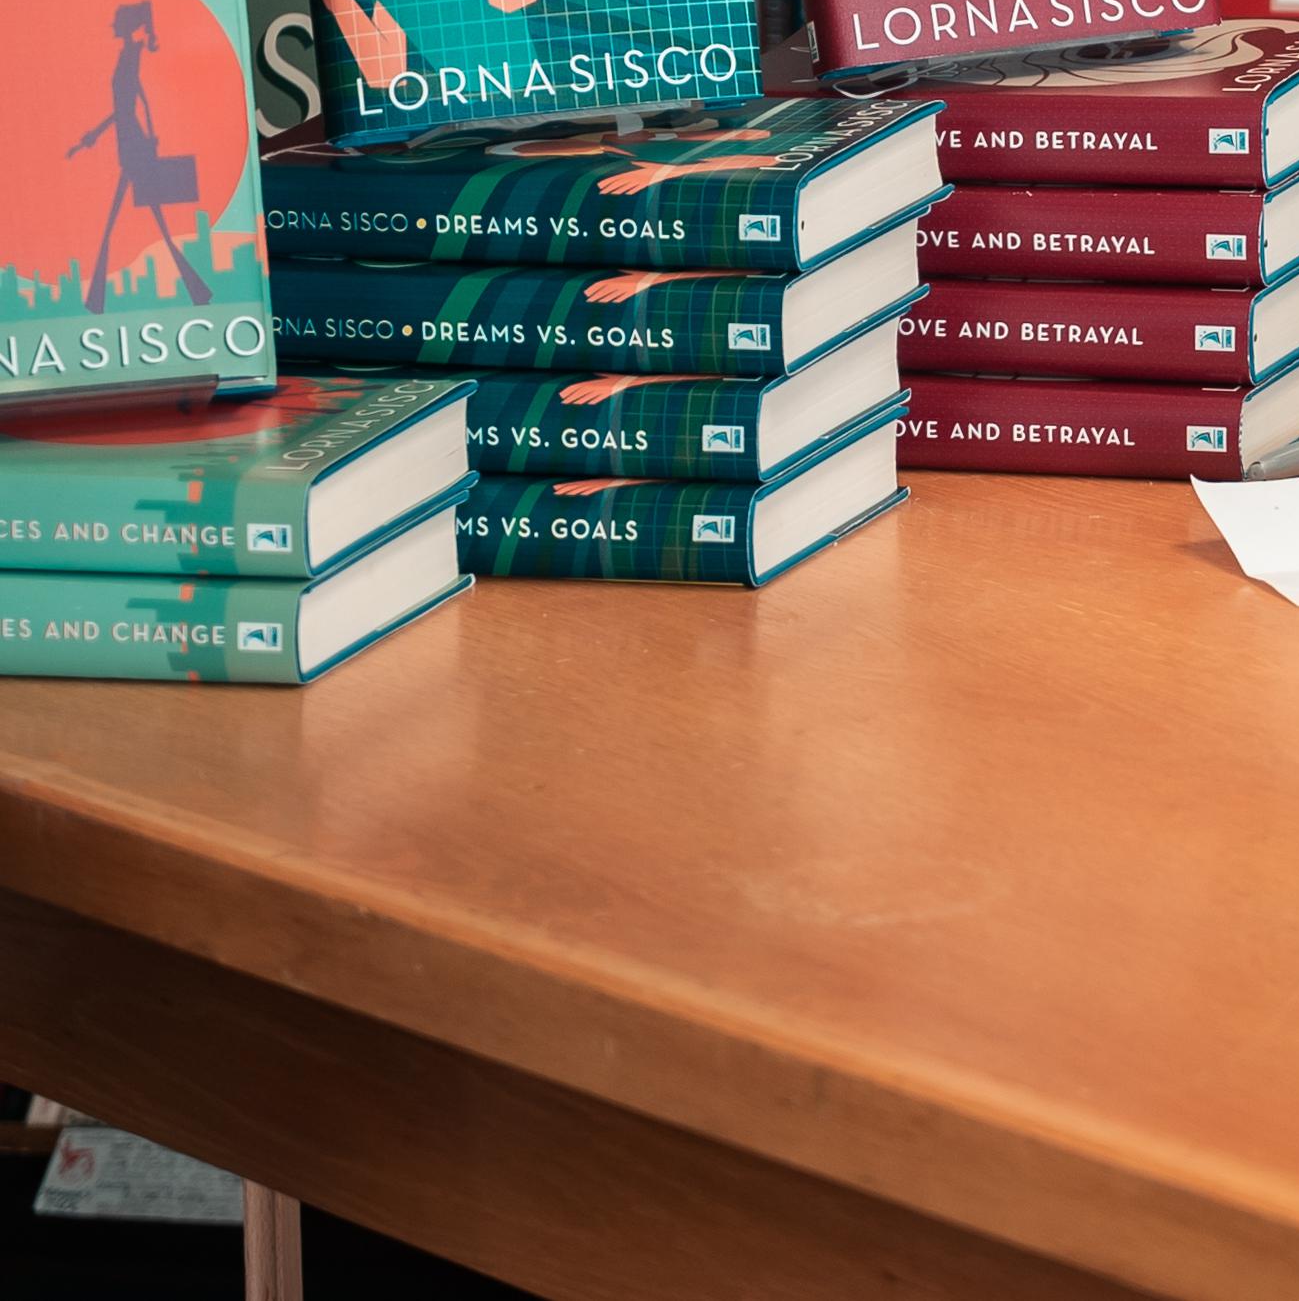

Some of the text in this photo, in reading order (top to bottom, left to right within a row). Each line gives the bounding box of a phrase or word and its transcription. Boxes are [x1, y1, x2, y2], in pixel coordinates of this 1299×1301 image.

[354, 42, 738, 116] LORNA SISCO
[759, 128, 863, 172] LORNA
[973, 130, 1025, 150] AND
[1035, 131, 1159, 151] BETRAYAL
[340, 211, 409, 233] SISCO
[435, 213, 539, 237] DREAMS
[549, 216, 588, 238] VS.
[600, 217, 687, 241] GOALS
[971, 231, 1022, 251] AND
[1032, 233, 1156, 255] BETRAYAL
[79, 314, 267, 372] SISCO
[325, 317, 395, 340] SISCO
[421, 320, 526, 344] DREAMS
[536, 324, 577, 346] VS.
[587, 325, 675, 349] GOALS
[898, 317, 1145, 347] OVE AND BETRAYAL
[265, 415, 364, 472] LORNA
[466, 425, 649, 451] MS VS. GOALS
[949, 421, 1001, 442] AND
[1012, 423, 1136, 447] BETRAYAL
[54, 521, 109, 543] AND
[121, 522, 236, 547] CHANGE
[456, 515, 639, 541] MS VS. GOALS
[44, 620, 101, 642] AND
[111, 621, 226, 646] CHANGE
